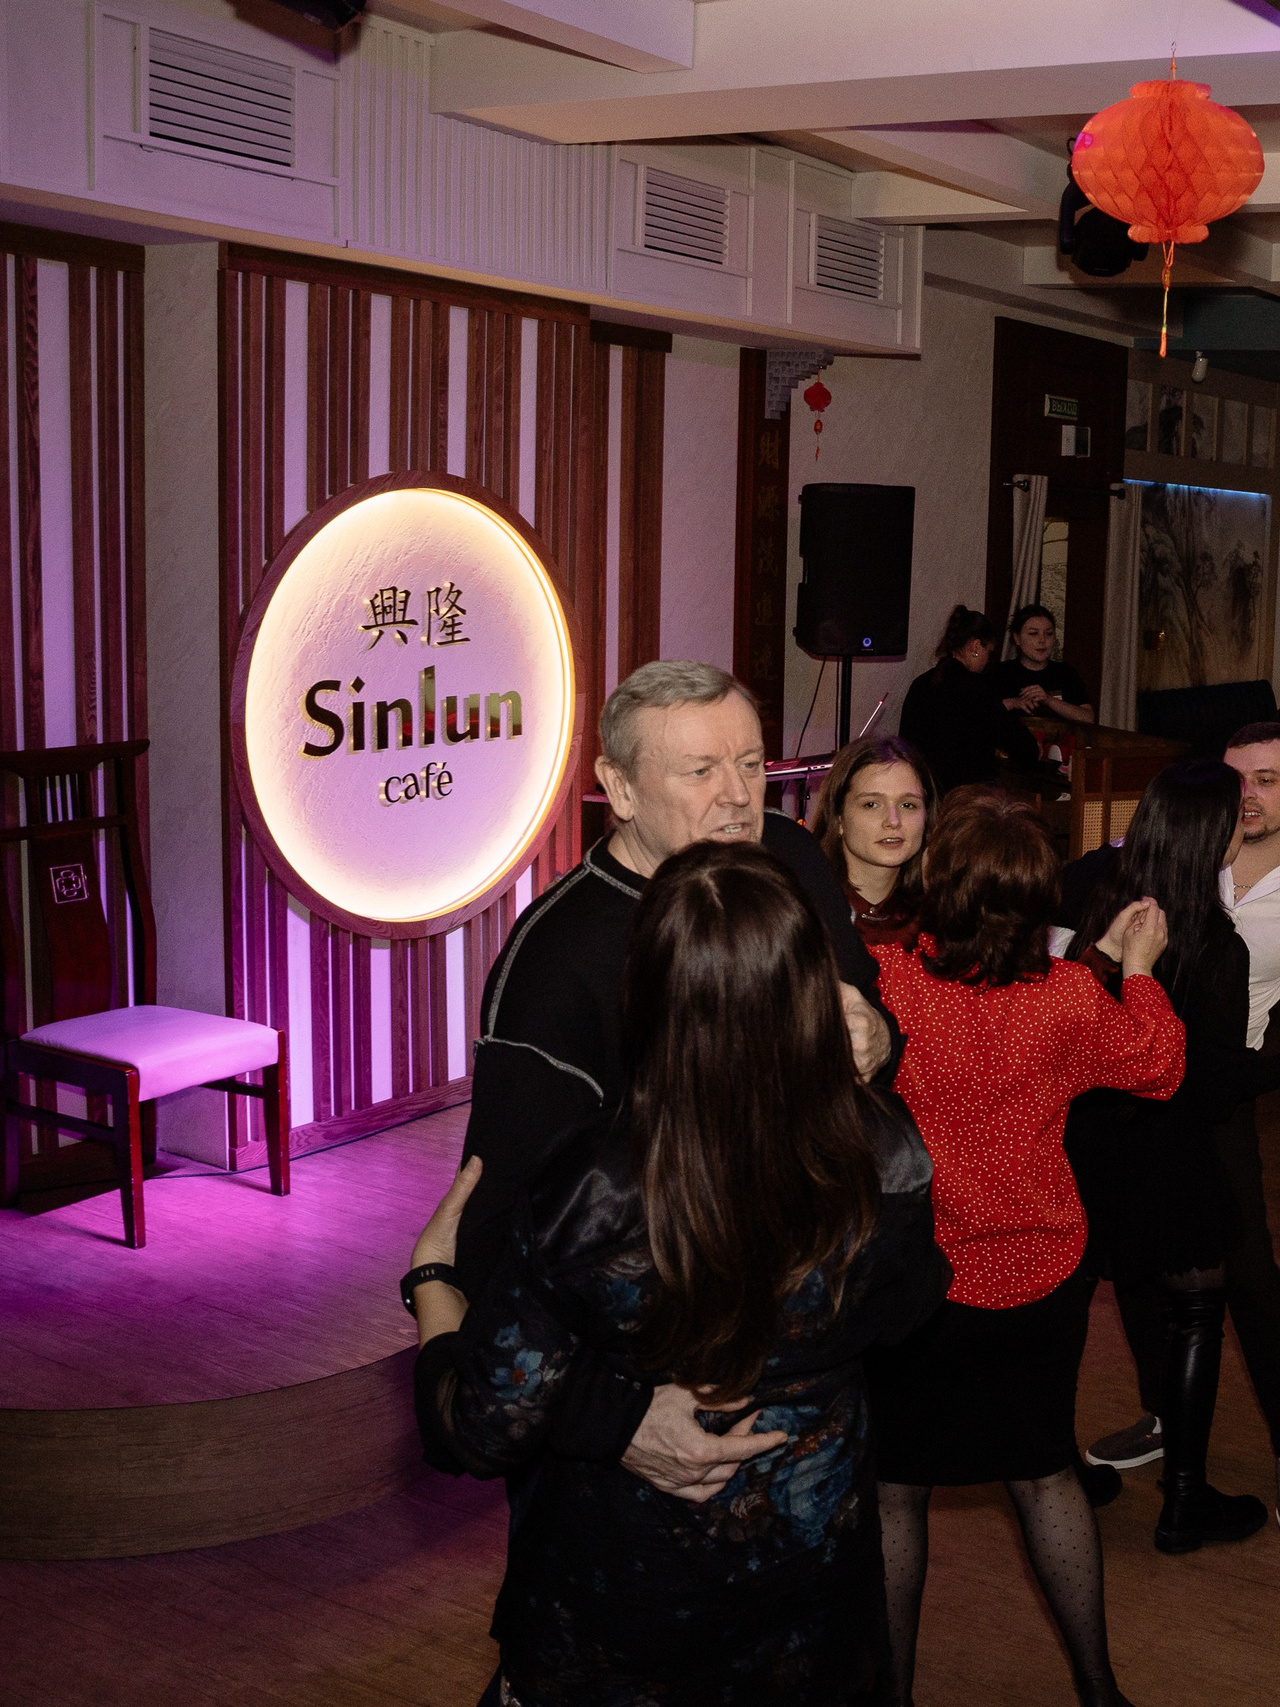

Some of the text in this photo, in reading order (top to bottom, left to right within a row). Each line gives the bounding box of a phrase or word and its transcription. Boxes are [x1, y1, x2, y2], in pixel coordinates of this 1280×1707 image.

[1052, 400, 1077, 415] ВЫХОД
[361, 581, 471, 650] 興隆
[302, 665, 522, 758] Sinlun
[384, 762, 453, 804] café
